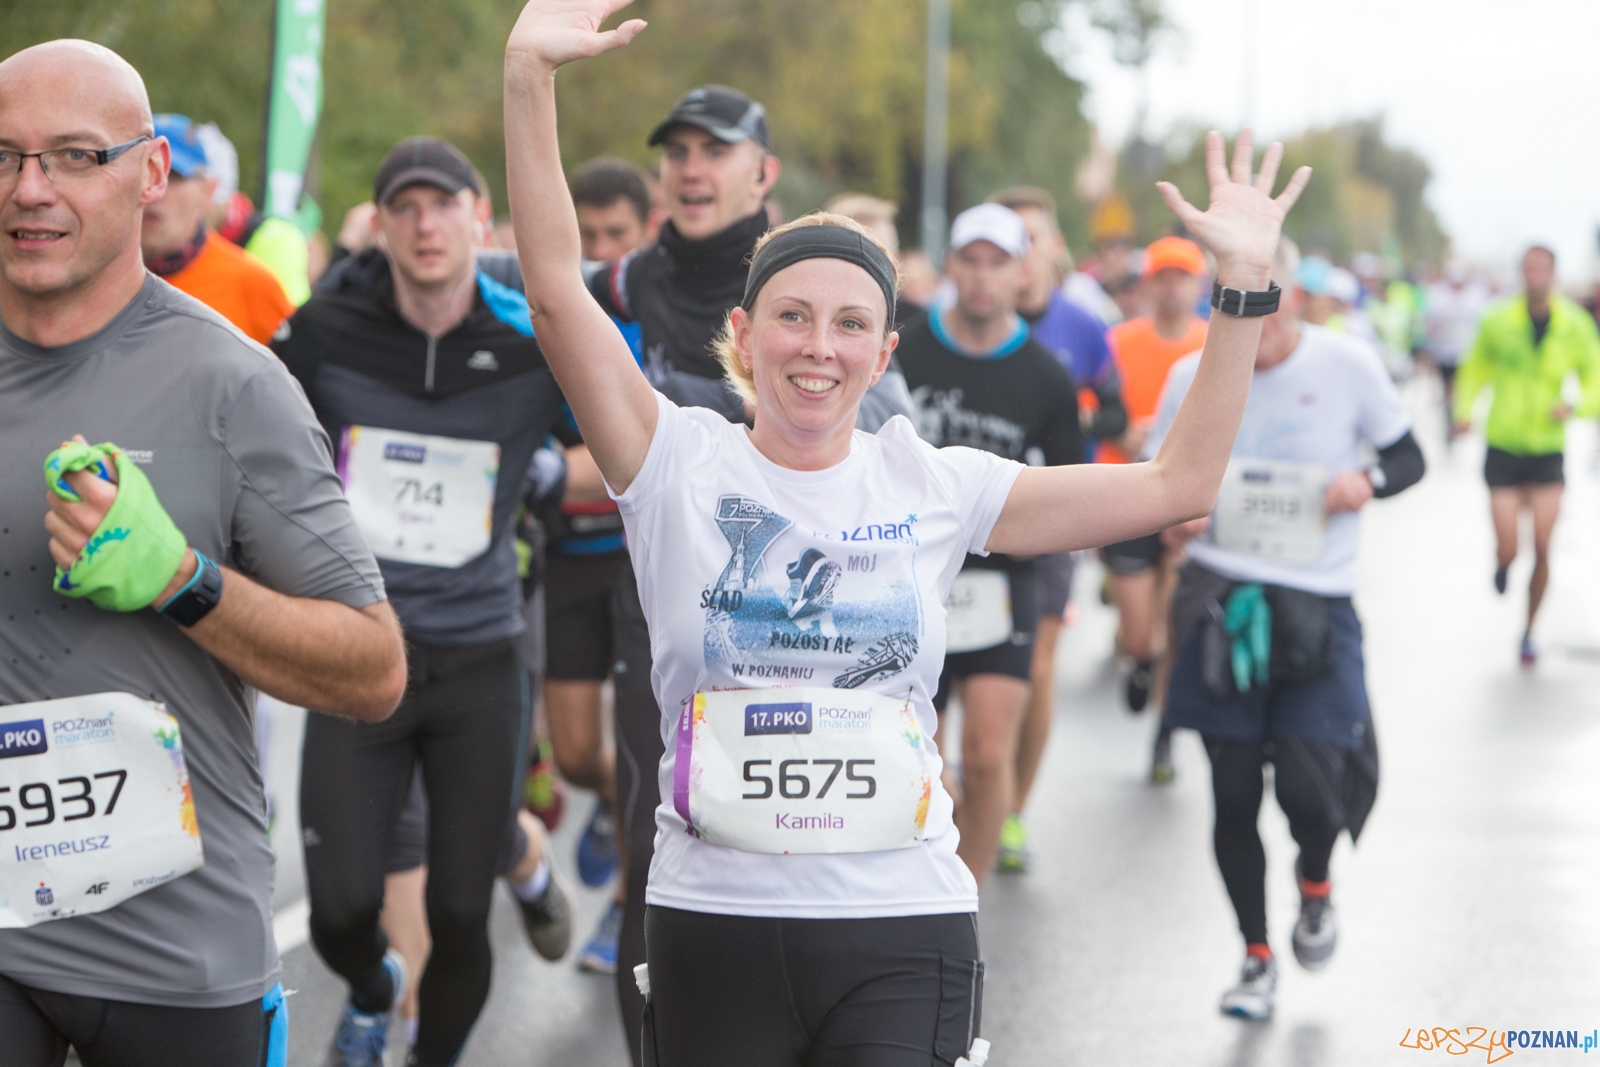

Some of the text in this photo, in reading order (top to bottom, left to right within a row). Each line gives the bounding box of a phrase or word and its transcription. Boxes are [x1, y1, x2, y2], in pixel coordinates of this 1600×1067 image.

[393, 477, 443, 506] 714
[847, 551, 877, 572] MÓJ
[732, 663, 815, 680] W POZNANIU
[751, 710, 808, 727] 17. PKO
[819, 718, 871, 730] maraton
[4, 728, 42, 750] PKO
[54, 727, 115, 746] maraton
[742, 758, 877, 800] 5675
[775, 812, 844, 830] Kamila
[15, 834, 111, 863] Ireneusz
